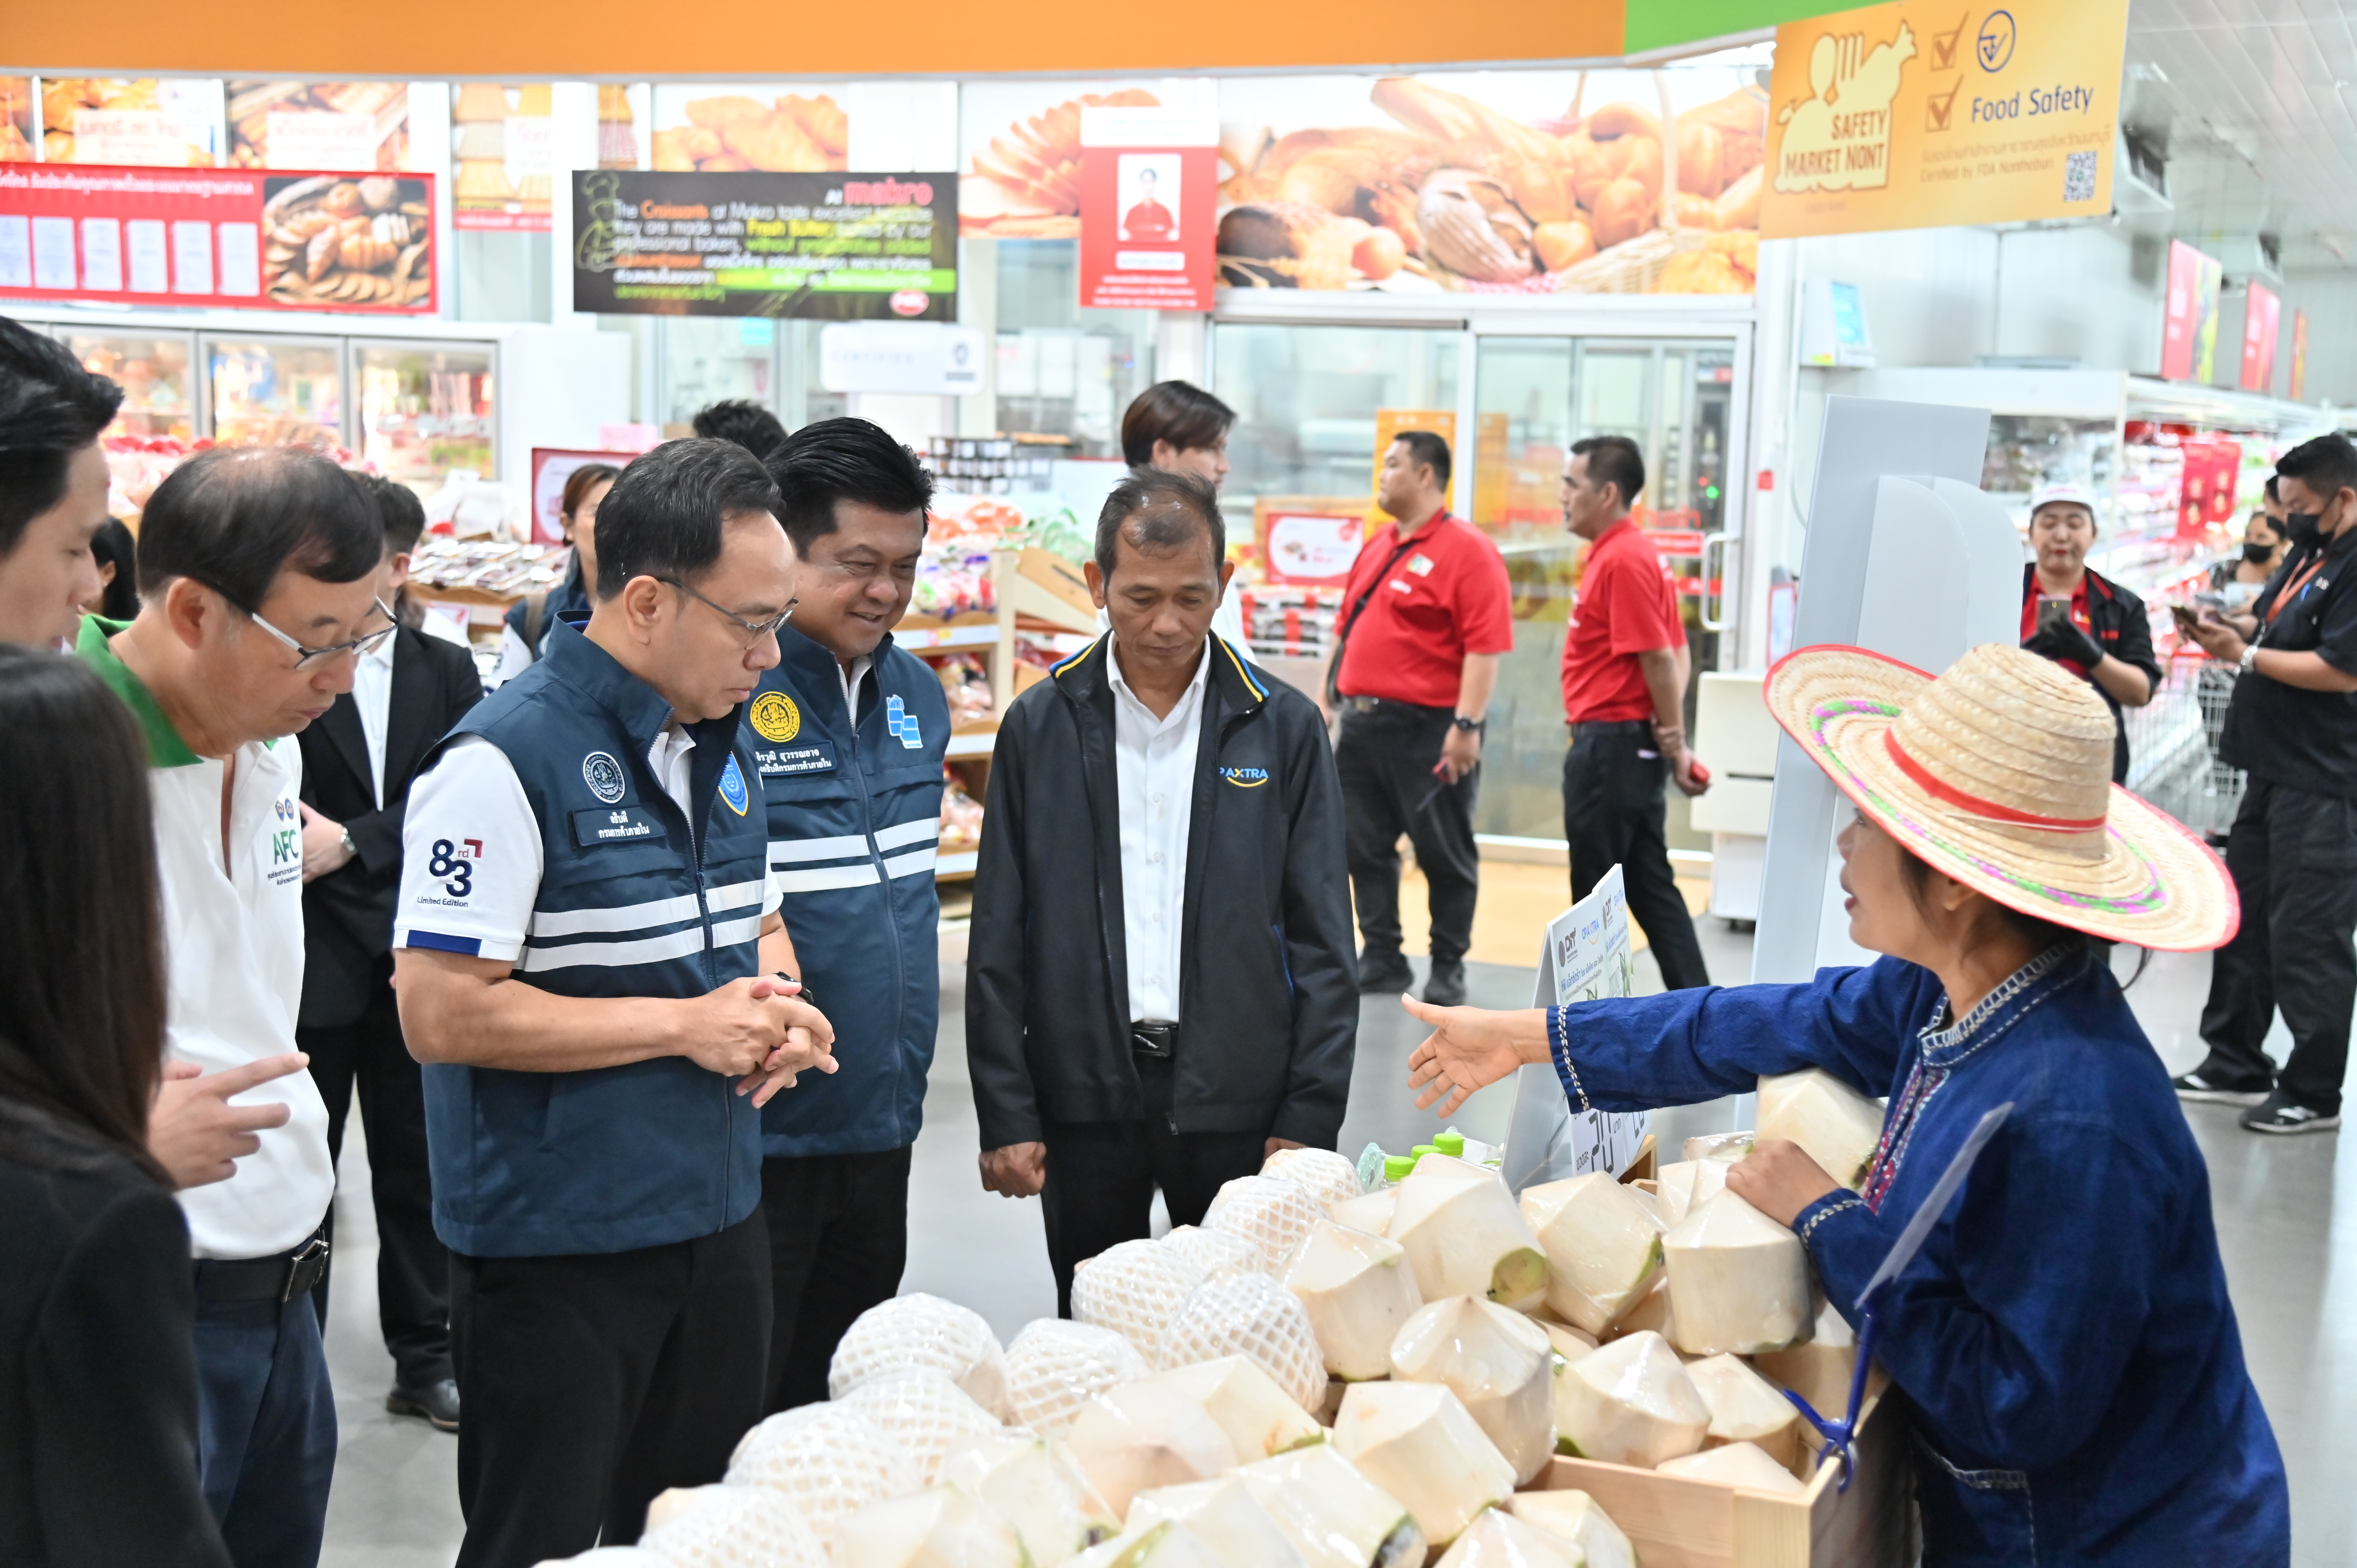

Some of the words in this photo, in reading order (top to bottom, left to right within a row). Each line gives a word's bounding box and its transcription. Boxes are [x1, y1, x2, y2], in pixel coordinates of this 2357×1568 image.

[1972, 90, 2020, 123] Food
[2028, 84, 2094, 116] Safety
[1832, 109, 1887, 141] SAFETY
[1785, 147, 1841, 178] MARKET
[1845, 143, 1884, 173] NONT
[1920, 165, 1959, 183] Certified
[1963, 164, 1972, 181] by
[1977, 163, 1996, 177] FDA
[1998, 157, 2054, 174] Nonthaburi
[844, 176, 933, 205] makro
[614, 199, 639, 219] The
[640, 200, 709, 220] Croissants
[710, 204, 727, 220] at
[728, 201, 776, 221] Makro
[777, 205, 810, 221] taste
[811, 205, 873, 221] excellent
[613, 220, 643, 239] they
[643, 221, 669, 235] are
[670, 220, 712, 236] made
[714, 219, 744, 236] with
[746, 219, 786, 237] Fresh
[907, 224, 932, 238] our
[746, 236, 795, 253] without
[883, 238, 932, 254] added
[759, 758, 832, 773] งอธิบดีกรมการค้าภายใน
[1226, 768, 1269, 779] AXTRA
[610, 810, 629, 823] อธิบดี
[598, 822, 650, 839] กรมการค้าภายใน
[273, 829, 299, 865] AFC
[429, 839, 472, 897] 83
[458, 849, 469, 858] rd
[417, 896, 441, 905] Limited
[442, 898, 468, 907] Edition
[1613, 1118, 1622, 1134] บาท
[1576, 1151, 1589, 1171] ขวดละ
